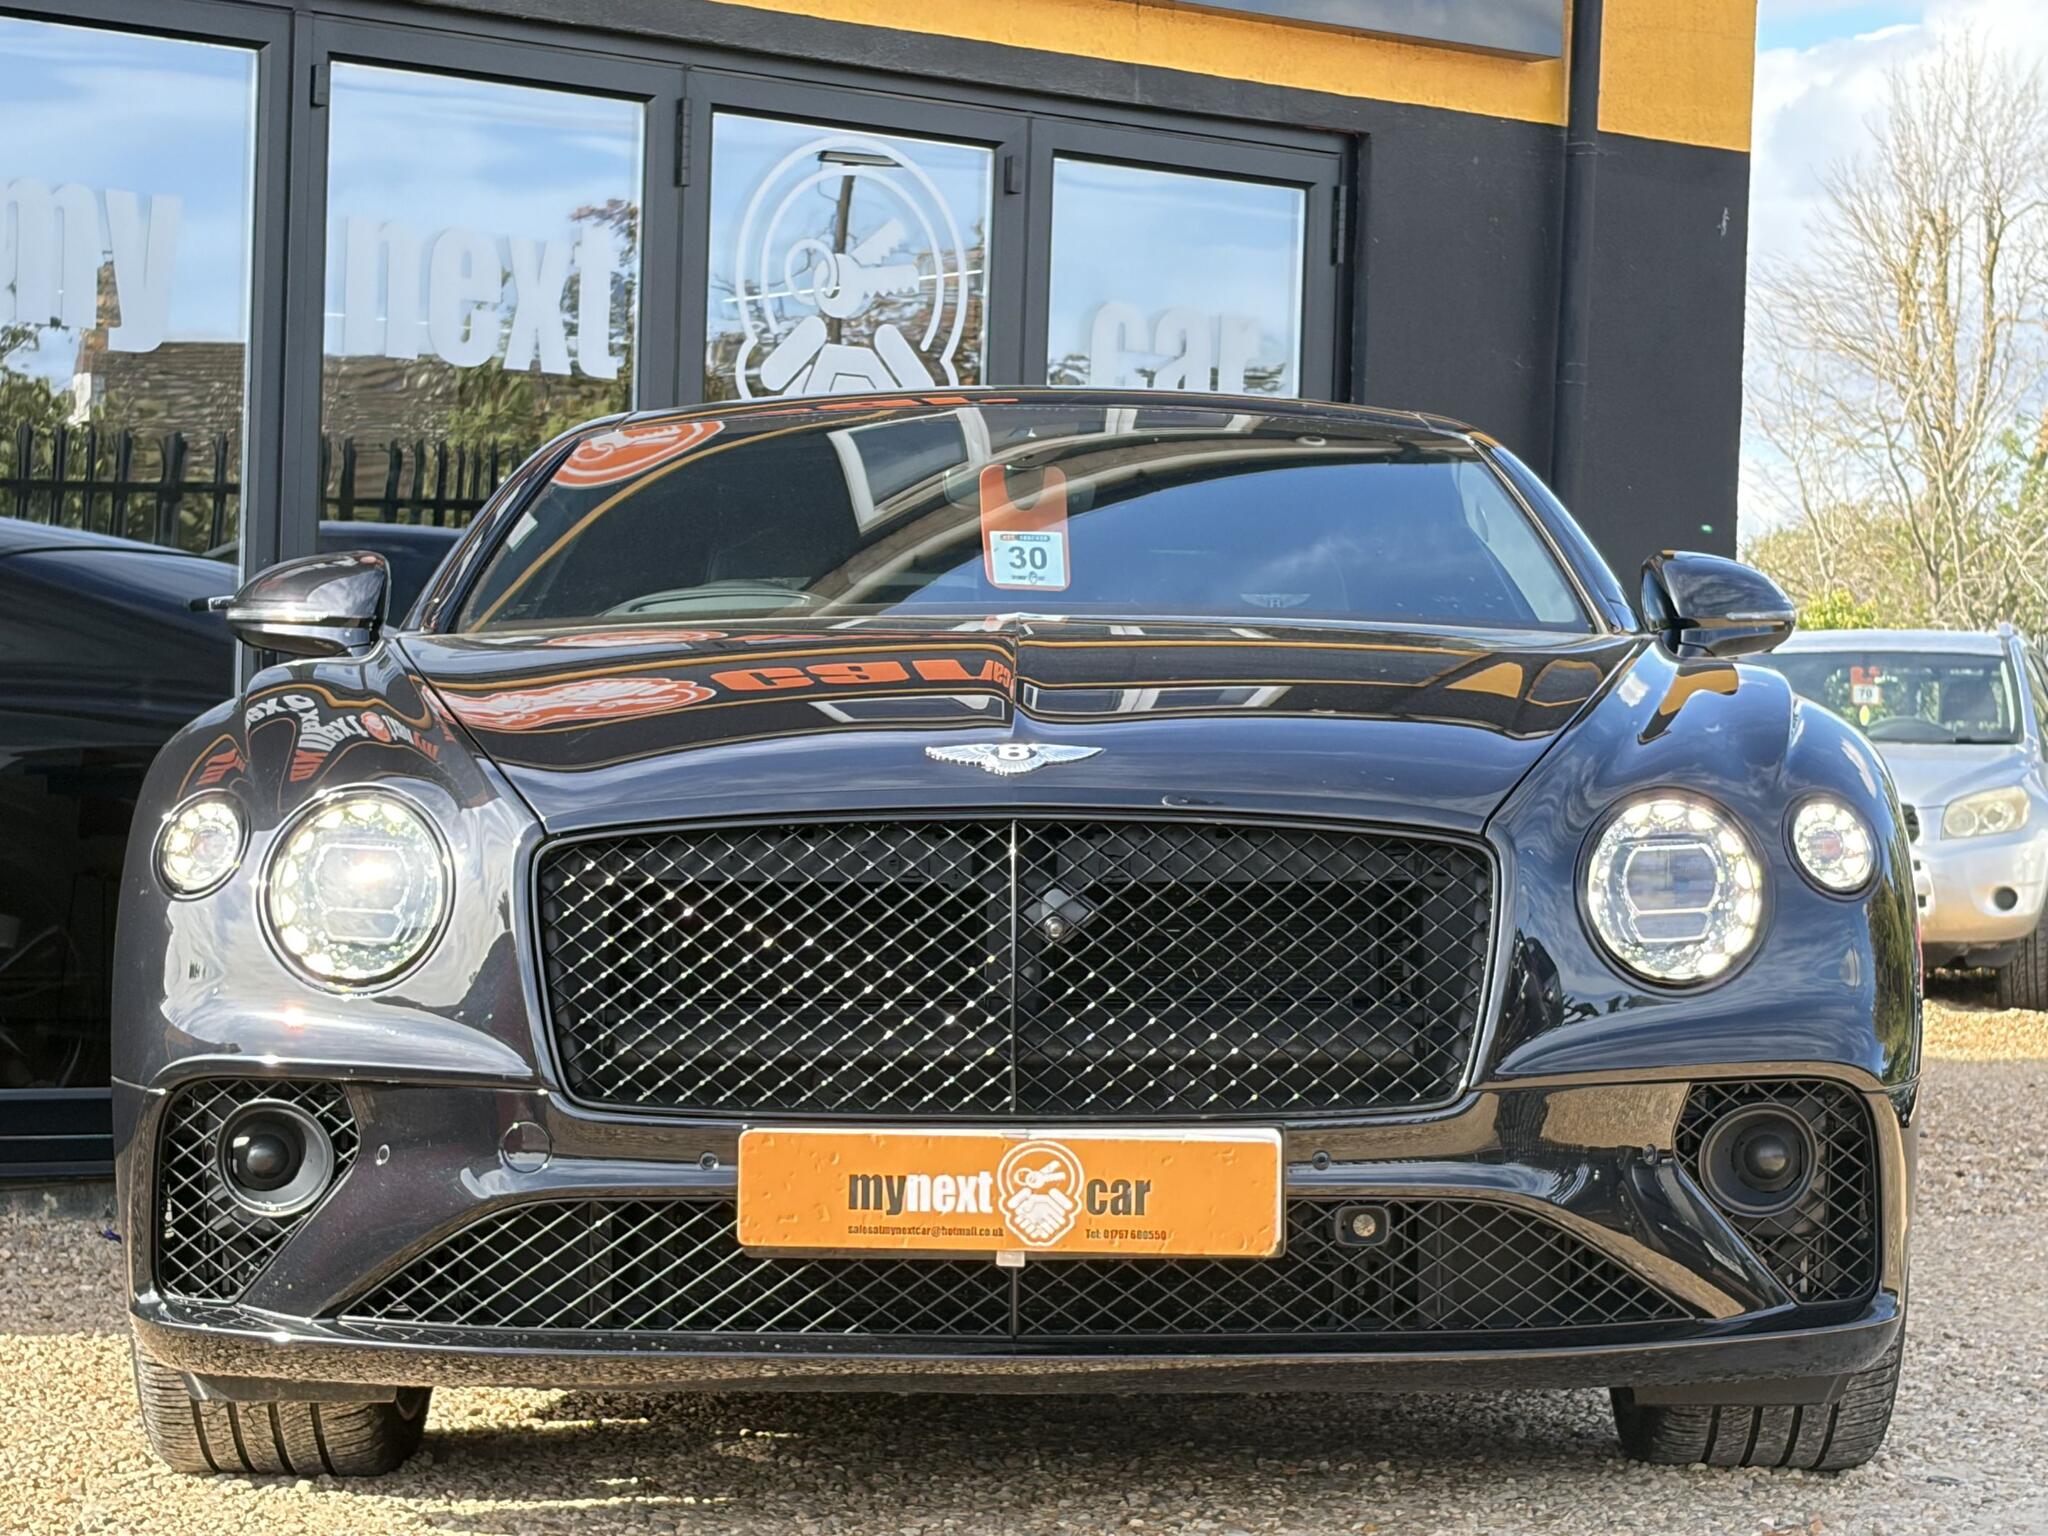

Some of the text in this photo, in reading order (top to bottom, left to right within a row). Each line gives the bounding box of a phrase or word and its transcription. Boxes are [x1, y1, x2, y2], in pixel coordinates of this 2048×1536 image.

[0, 177, 184, 353] my
[343, 217, 619, 380] next
[1008, 546, 1048, 570] 30
[1086, 1178, 1152, 1216] car
